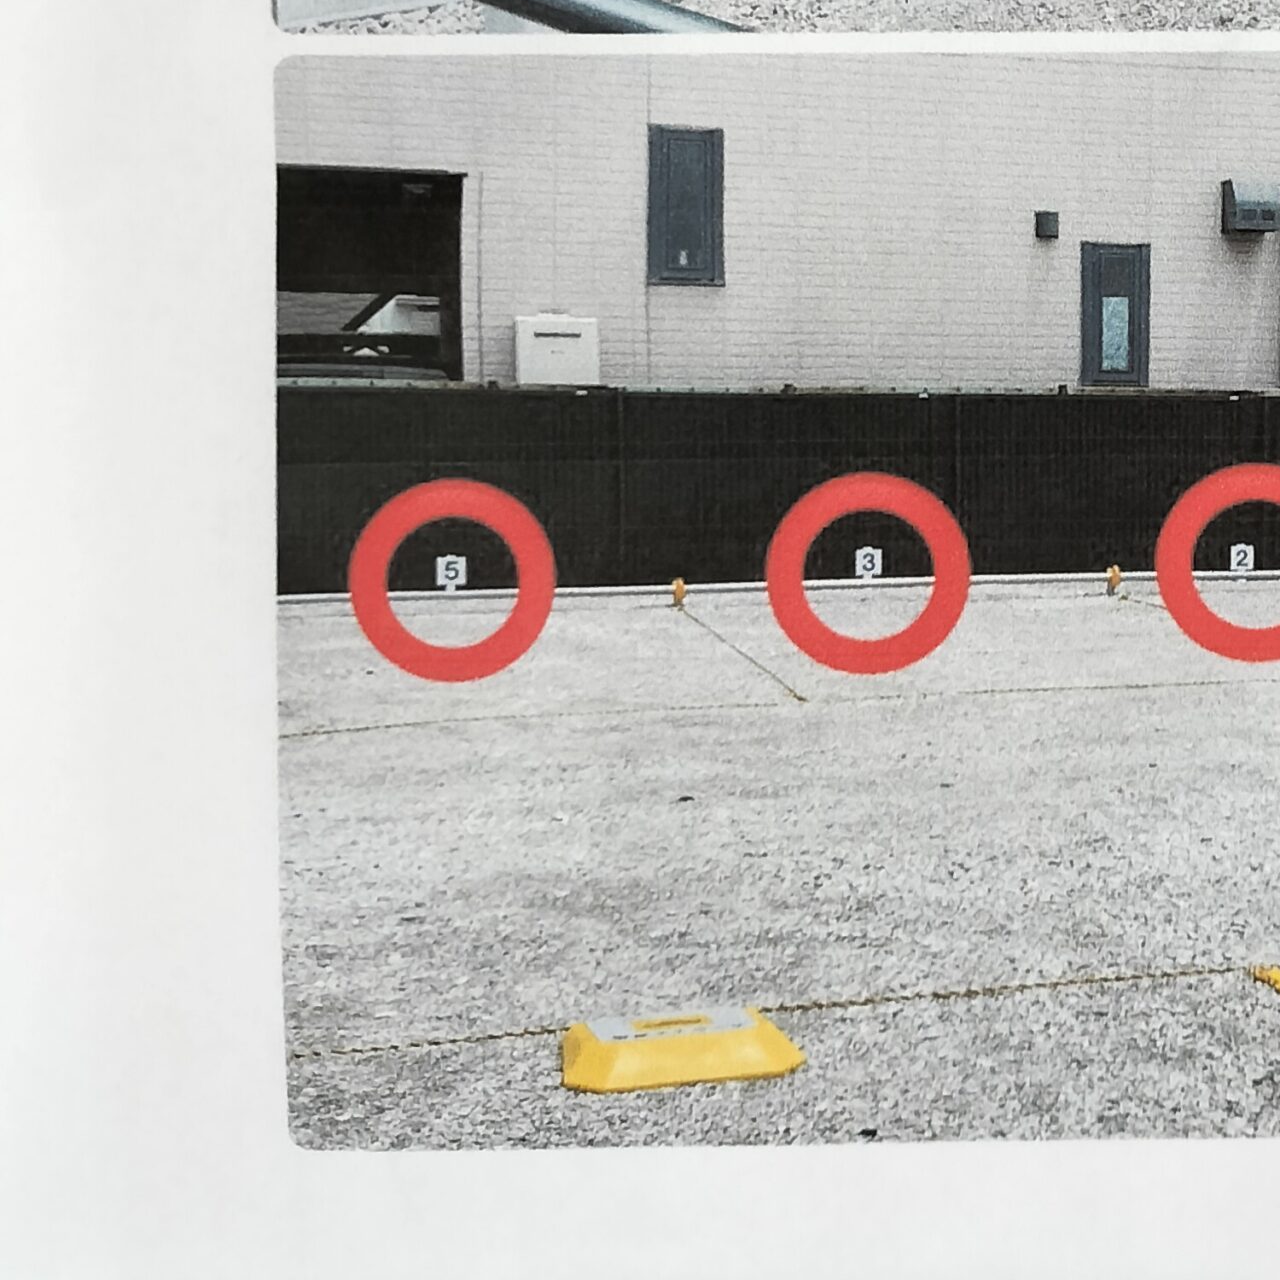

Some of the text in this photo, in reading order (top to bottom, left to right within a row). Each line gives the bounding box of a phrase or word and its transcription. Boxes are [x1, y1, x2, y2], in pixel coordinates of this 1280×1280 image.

[862, 552, 876, 572] 3
[1236, 549, 1248, 567] 2
[444, 560, 460, 581] 5
